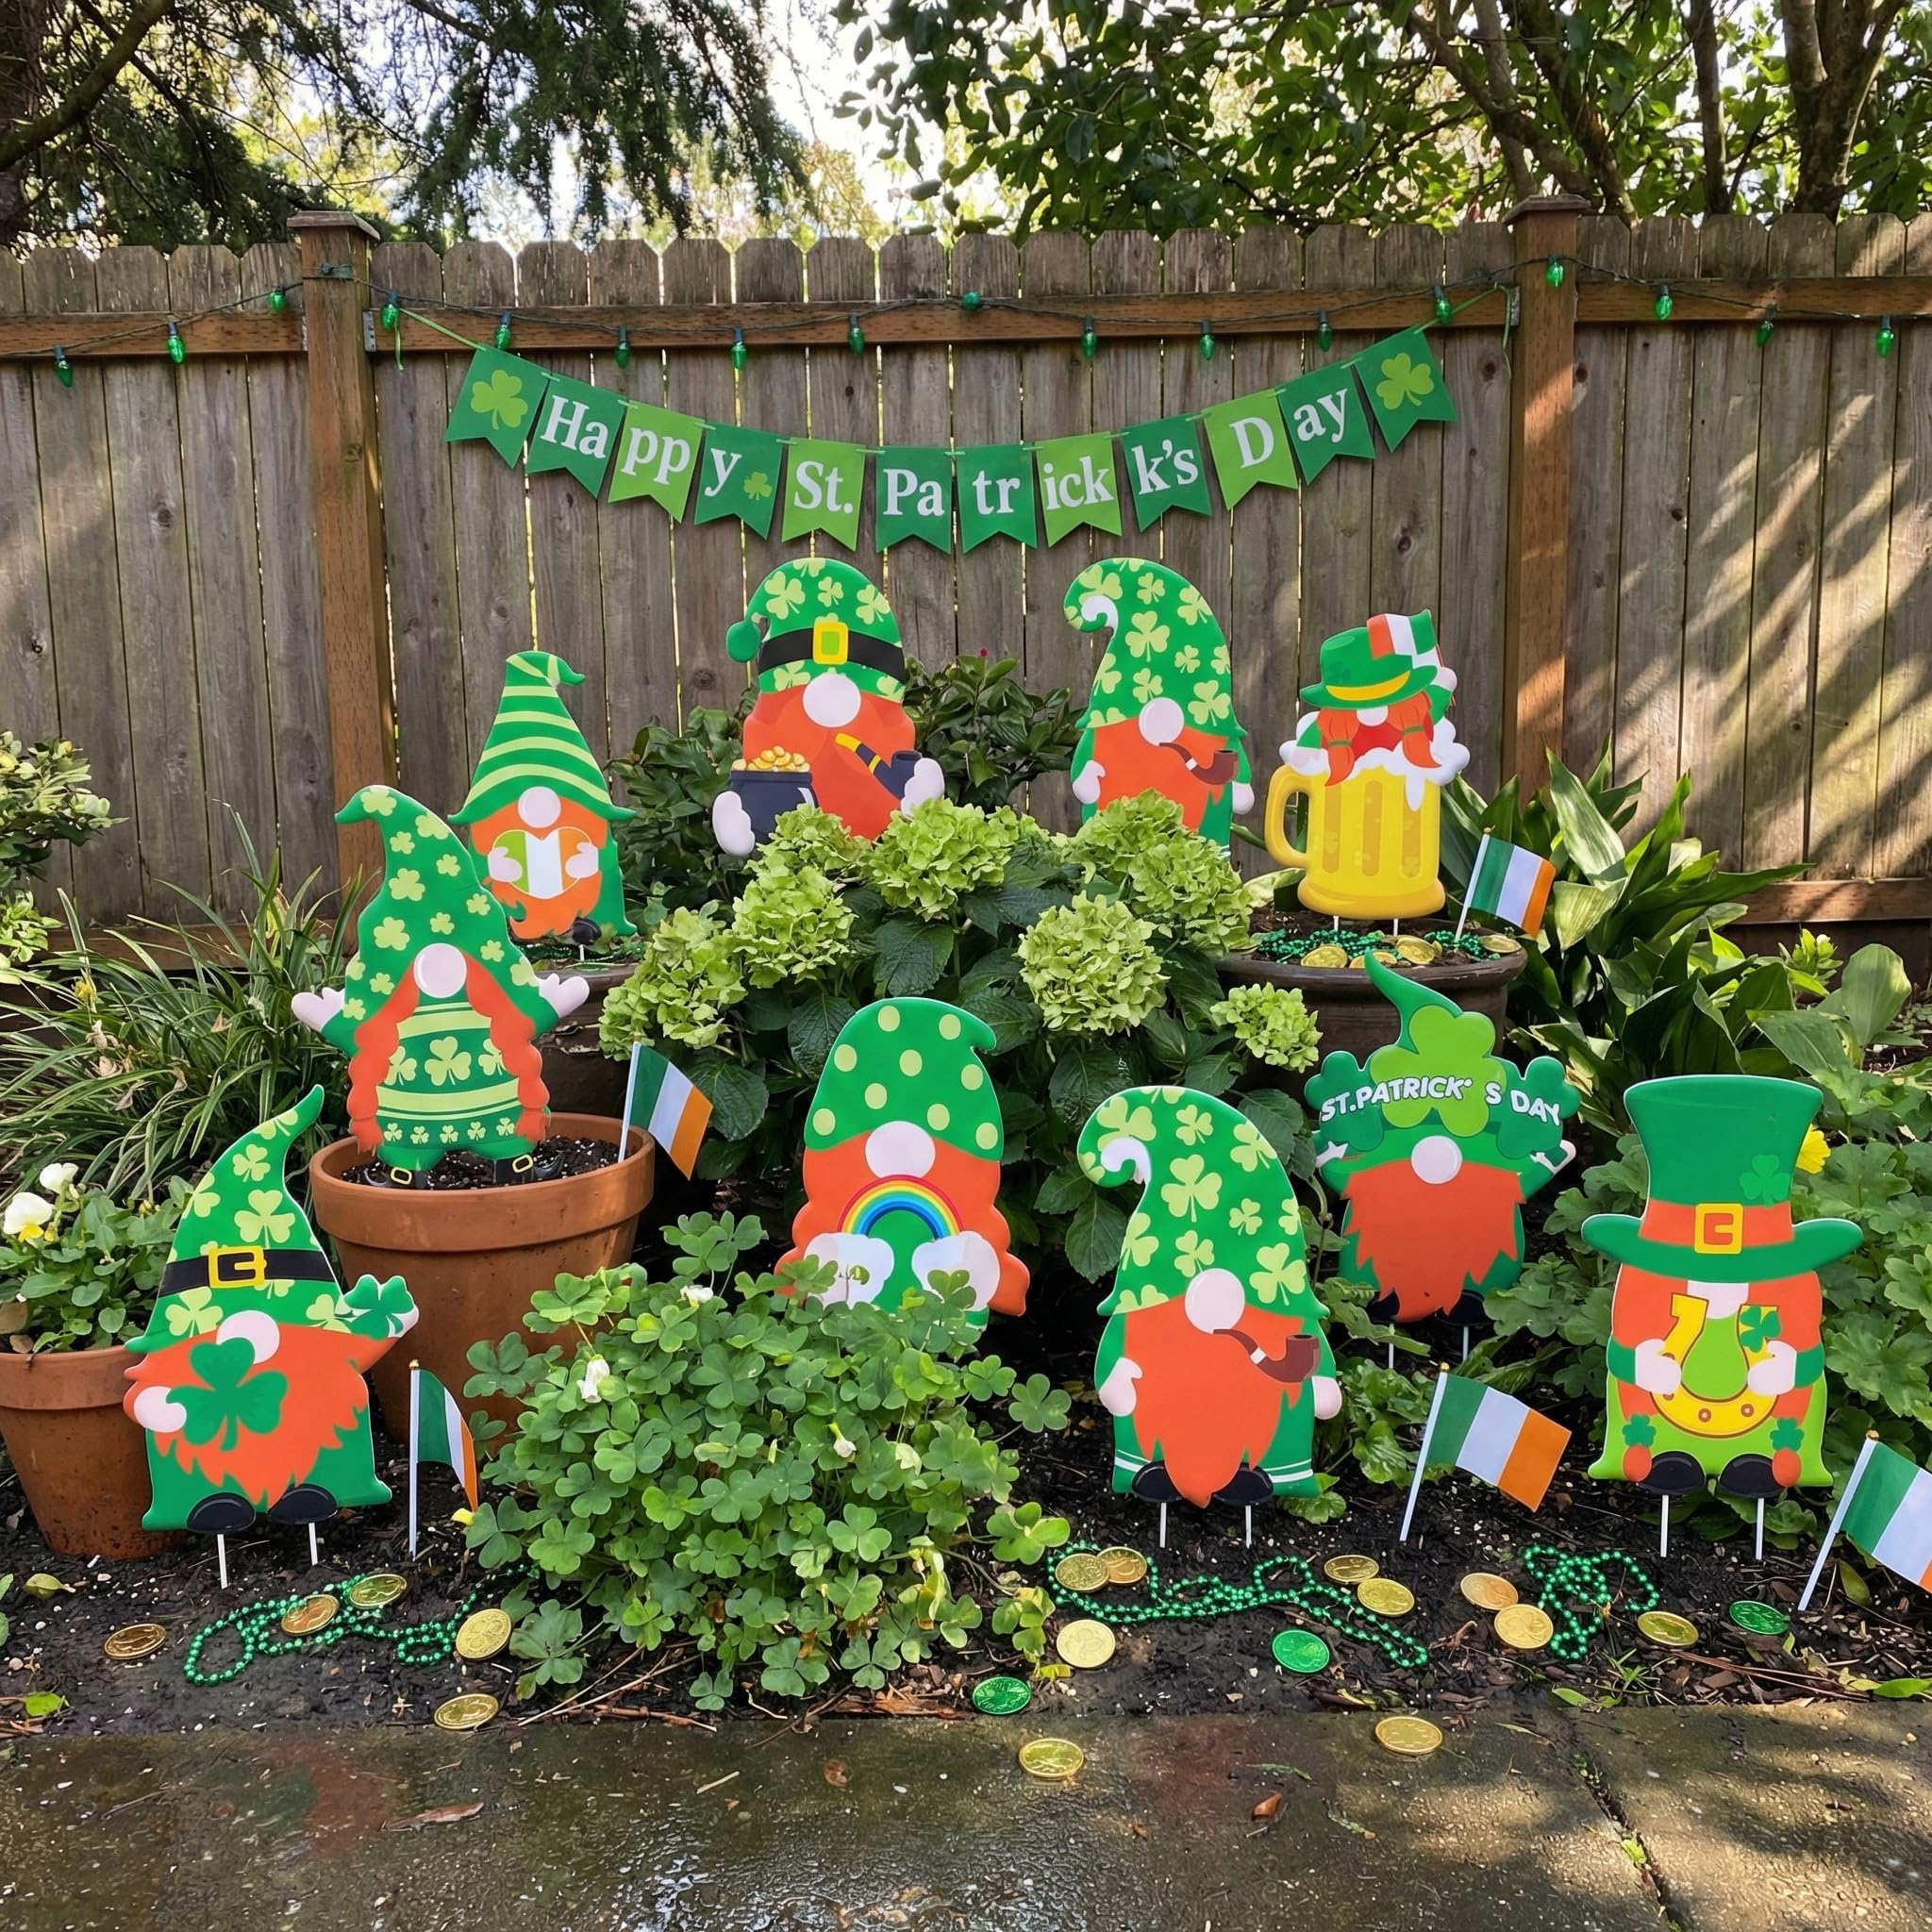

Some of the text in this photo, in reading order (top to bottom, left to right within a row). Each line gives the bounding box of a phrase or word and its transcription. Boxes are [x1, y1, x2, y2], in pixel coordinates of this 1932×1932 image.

[541, 394, 741, 497] Happy
[793, 459, 854, 514] St.
[1231, 388, 1349, 469] Day
[1510, 1090, 1560, 1126] DAY
